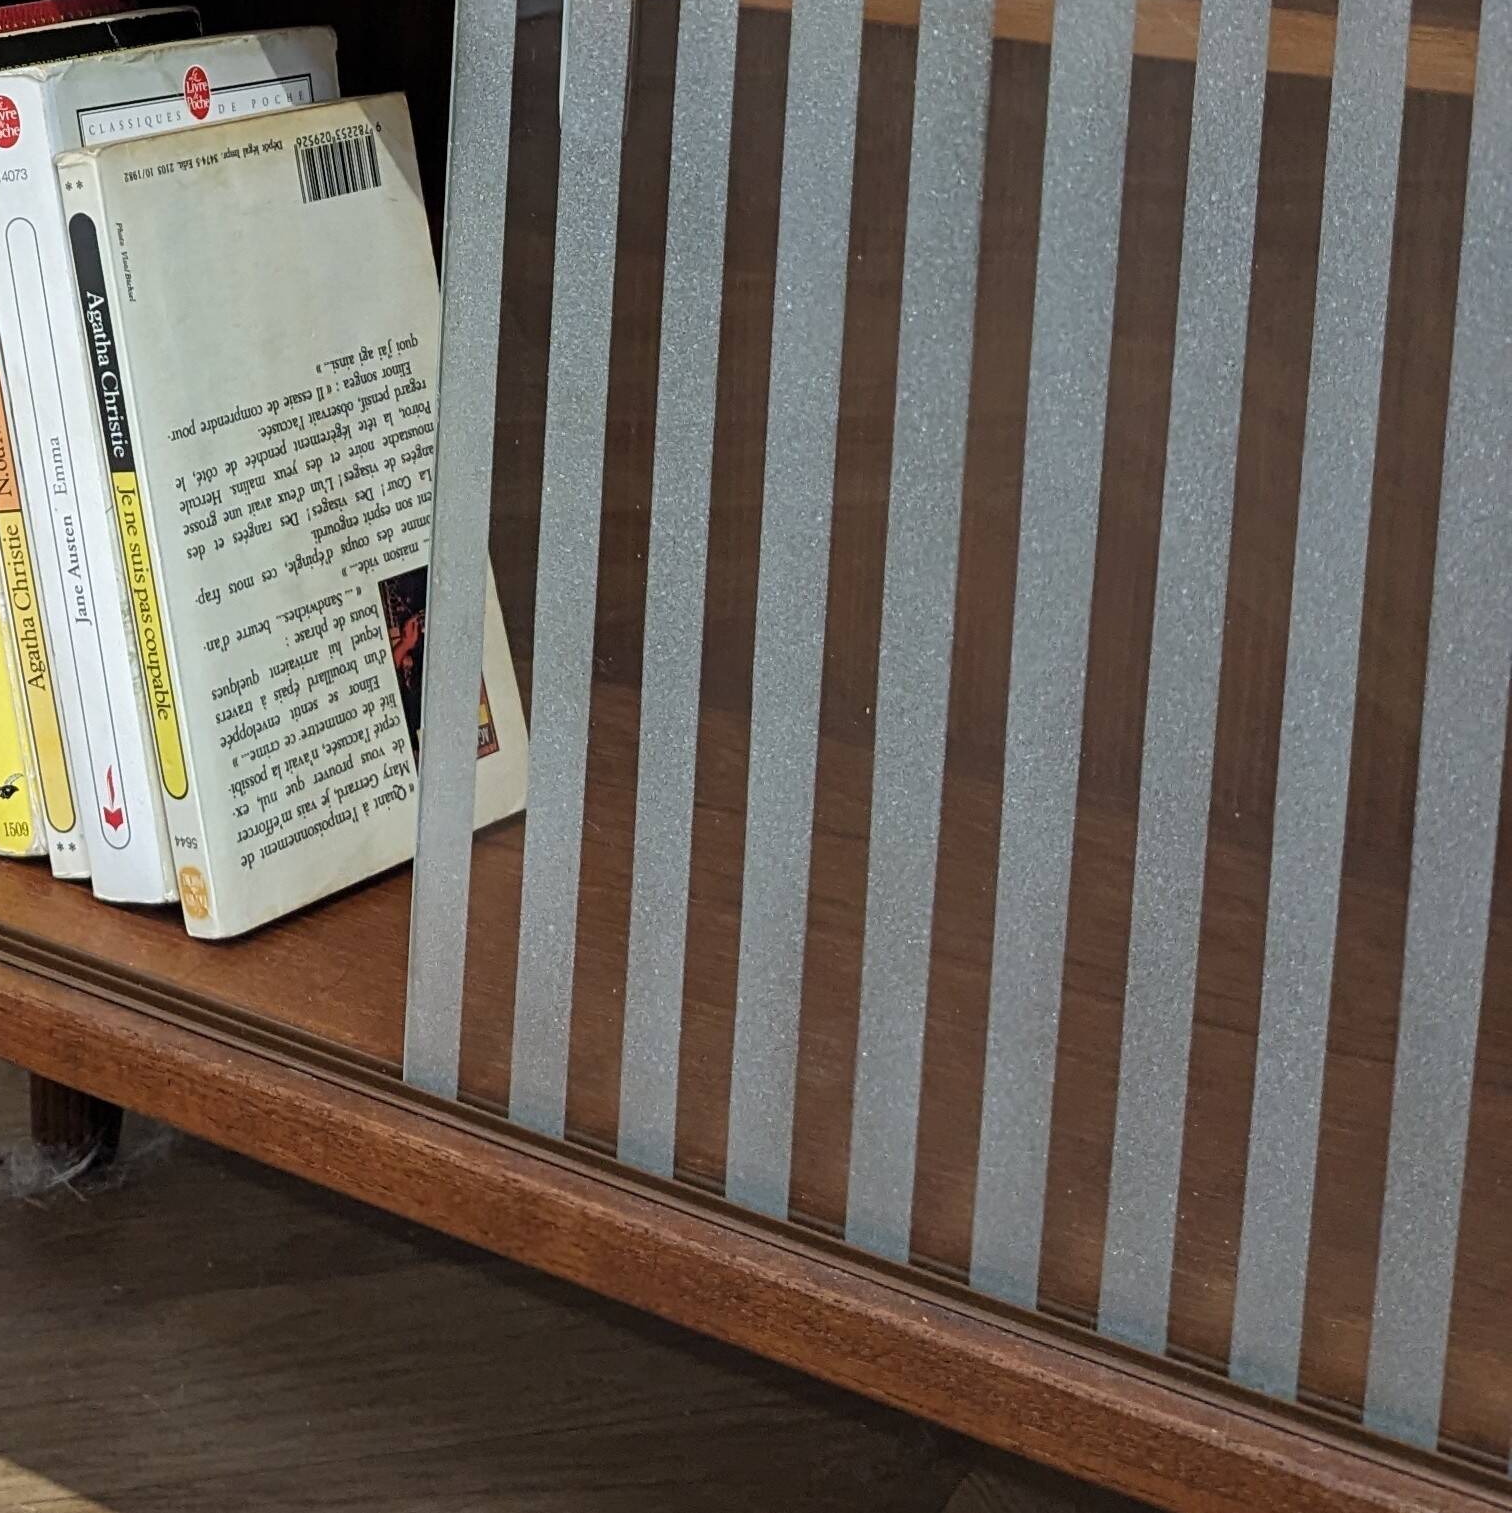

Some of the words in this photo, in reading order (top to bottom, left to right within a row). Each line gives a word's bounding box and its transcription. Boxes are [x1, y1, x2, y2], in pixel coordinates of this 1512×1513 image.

[186, 81, 208, 92] Livre
[188, 96, 209, 109] Poche
[88, 110, 182, 136] CLASSIQUES
[218, 101, 237, 114] DE
[251, 90, 304, 109] POCHE
[335, 124, 368, 140] 782253
[375, 120, 381, 132] 9
[295, 131, 331, 147] 029526
[377, 338, 392, 360] j'ai
[395, 332, 418, 355] quoi
[358, 345, 373, 365] agi
[86, 291, 109, 366] Agatha
[100, 372, 125, 458] Christie
[342, 370, 377, 388] songea
[381, 361, 411, 377] Elinor
[266, 399, 279, 415] de
[283, 389, 312, 409] essaie
[398, 400, 431, 417] Poirot,
[200, 404, 262, 433] comprendre
[357, 416, 377, 431] tête
[382, 411, 393, 426] la
[167, 418, 196, 441] pour-
[293, 422, 351, 451] légèrement
[382, 422, 433, 447] moustache
[244, 438, 286, 468] penchée
[329, 451, 340, 463] et
[348, 440, 374, 457] noire
[52, 437, 68, 496] Emma
[224, 460, 237, 476] de
[272, 459, 298, 480] yeux
[304, 456, 322, 472] des
[175, 476, 186, 492] le
[192, 466, 217, 486] côté,
[418, 468, 432, 481] La
[117, 486, 136, 503] Je
[229, 475, 265, 495] malins.
[354, 487, 374, 501] Des
[179, 489, 221, 514] Hercule
[124, 510, 138, 537] ne
[279, 511, 299, 526] Des
[232, 520, 272, 543] rangées
[66, 514, 82, 579] Austen
[186, 544, 205, 560] des
[213, 537, 224, 550] et
[4, 523, 32, 610] Christie
[129, 543, 146, 584] suis
[74, 587, 93, 625] Jane
[134, 590, 151, 622] pas
[21, 616, 45, 690] Agatha
[143, 627, 172, 721] coupable
[348, 675, 379, 695] Elinor
[327, 690, 338, 703] se
[379, 693, 396, 711] lité
[289, 699, 318, 721] sentit
[362, 701, 374, 717] de
[220, 714, 280, 749] enveloppée
[301, 708, 357, 739] commettre
[373, 713, 399, 738] cepté
[284, 733, 296, 746] ce
[321, 727, 370, 755] l'accusée,
[391, 738, 404, 753] de
[284, 748, 319, 773] n'avait
[360, 746, 385, 763] vous
[270, 763, 282, 779] la
[313, 753, 353, 784] prouver
[383, 760, 409, 778] Mary
[228, 764, 267, 798] possibi-
[285, 775, 305, 796] que
[333, 773, 378, 803] Gerrard,
[256, 790, 277, 812] nul,
[320, 787, 331, 808] je
[373, 784, 406, 808] Quant
[232, 803, 249, 817] ex-
[296, 800, 317, 818] vais
[361, 801, 369, 816] à
[3, 821, 30, 837] 1509
[237, 809, 292, 842] m'efforcer
[260, 807, 358, 858] l'empoisonnement
[175, 836, 198, 849] 5644
[240, 852, 254, 869] de
